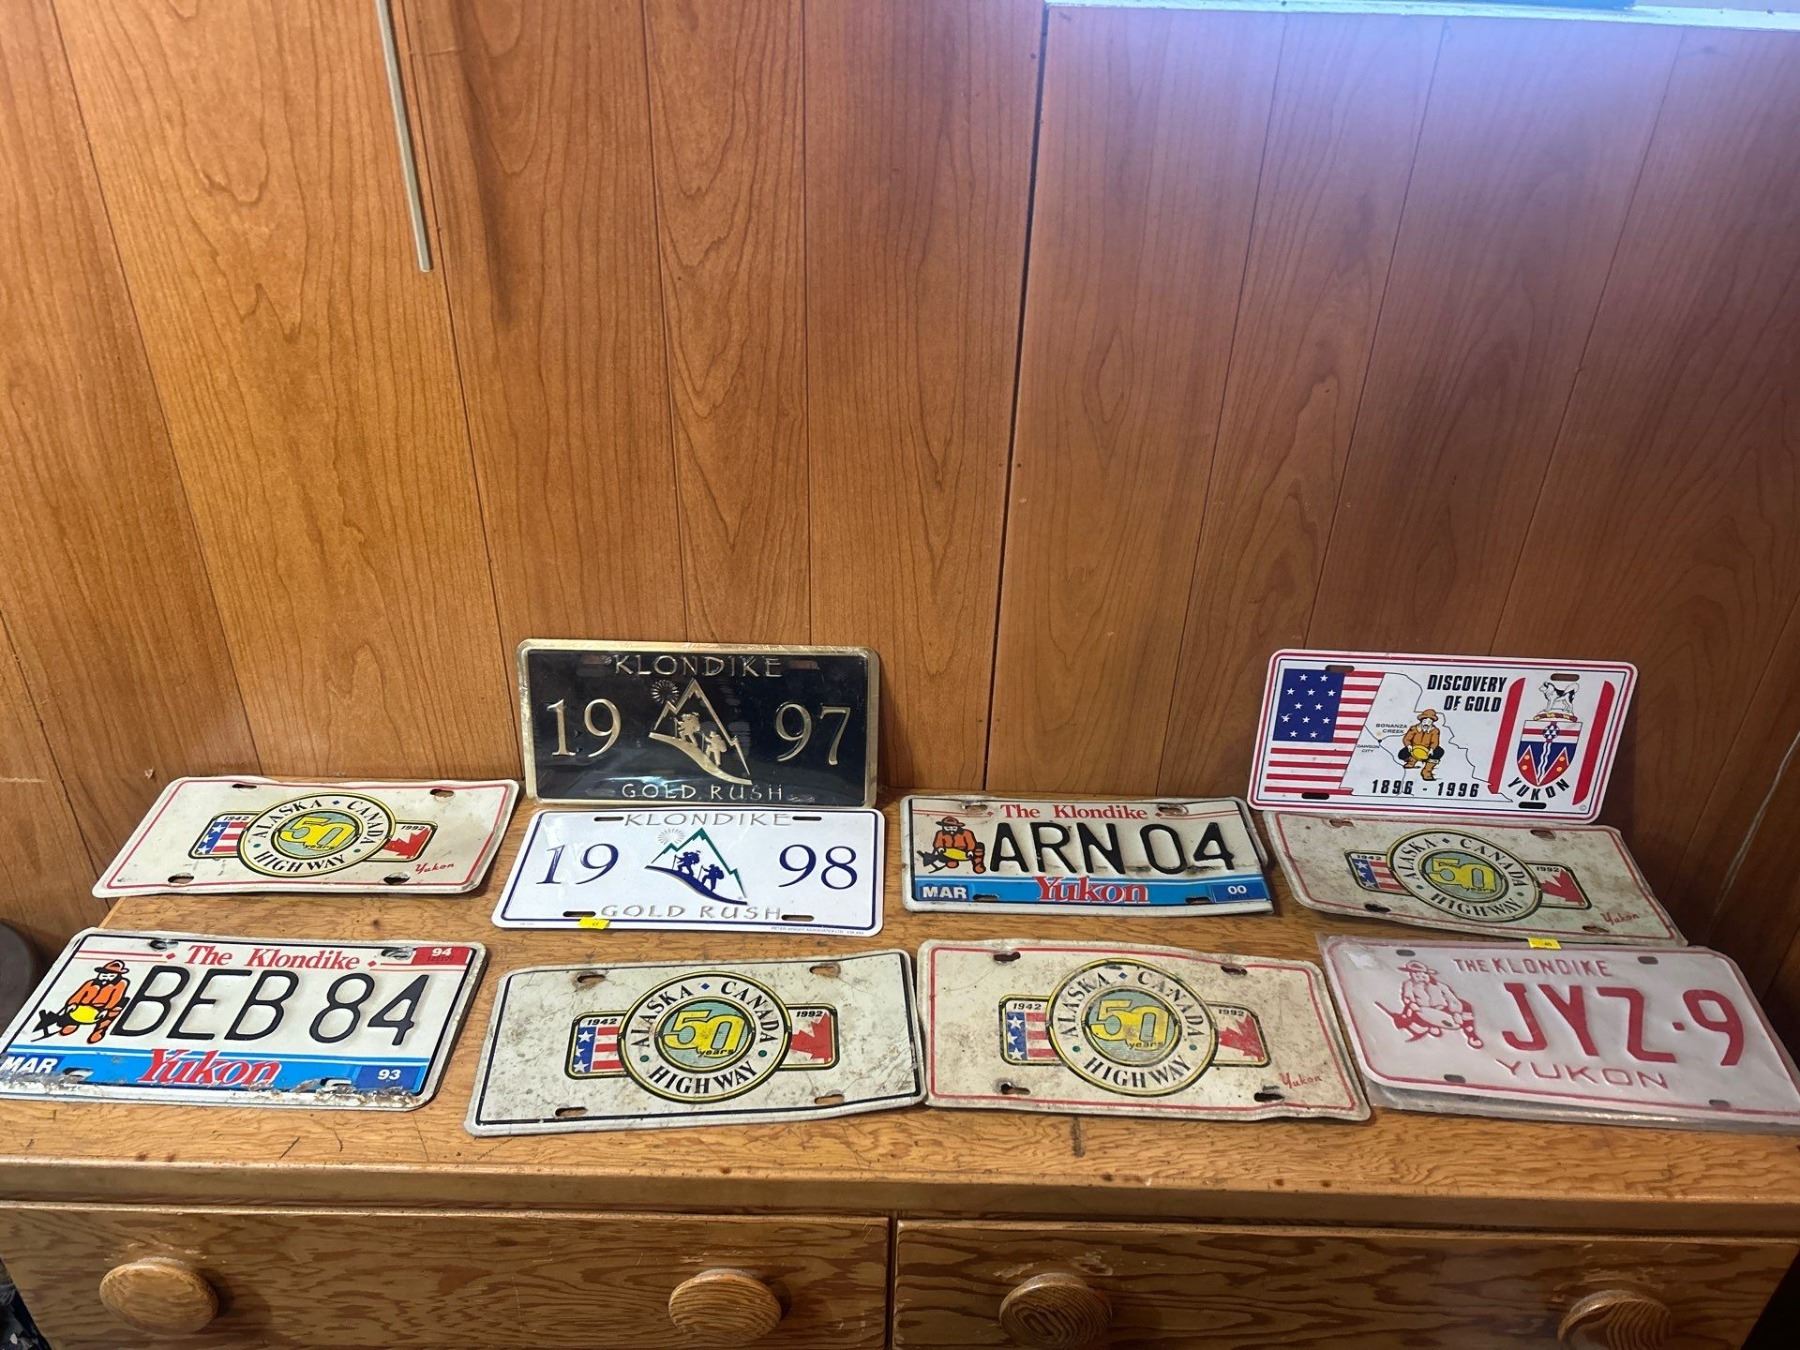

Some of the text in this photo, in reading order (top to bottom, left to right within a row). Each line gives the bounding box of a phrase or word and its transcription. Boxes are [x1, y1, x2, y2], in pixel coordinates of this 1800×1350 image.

[614, 654, 783, 678] KLONDIKE
[1426, 674, 1507, 693] DISCOVERY
[1443, 695, 1502, 713] OF GOLD
[547, 699, 851, 766] 19 97
[622, 783, 783, 801] GOLD RUSH
[1372, 779, 1413, 795] 1896
[1437, 782, 1480, 797] 1996
[1507, 777, 1570, 801] YUKON
[253, 800, 385, 845] ALASKA CANADA
[624, 813, 793, 827] KLONDIKE
[1001, 804, 1148, 820] The Klondike
[279, 816, 356, 848] 50
[990, 822, 1235, 875] ARN 04
[253, 850, 346, 873] HIGHWAY
[415, 862, 455, 875] Yukon
[536, 843, 858, 890] 19 98
[1401, 837, 1528, 888] ALASKA CANADA
[1429, 858, 1496, 891] 50
[922, 885, 967, 900] MAR
[1032, 875, 1149, 904] Yukon
[1227, 885, 1248, 895] 00
[601, 904, 781, 920] GOLD RUSH
[1430, 892, 1524, 917] HIGHWAY
[1604, 911, 1640, 926] Yukon
[185, 946, 361, 970] The Klondike
[432, 948, 452, 956] 94
[1453, 958, 1612, 977] THE KLONDIKE
[110, 965, 430, 1046] BEB 84
[631, 981, 779, 1047] ALASKA CANADA
[796, 1010, 824, 1018] 1992
[1012, 1003, 1042, 1011] 1942
[1059, 971, 1206, 1038] ALASKA CANADA
[586, 1018, 618, 1027] 1942
[662, 1009, 744, 1057] 50
[1089, 999, 1168, 1051] 50
[698, 1047, 736, 1057] years
[1128, 1040, 1164, 1051] years
[0, 1056, 58, 1074] MAR
[137, 1050, 284, 1088] Yukon
[377, 1069, 401, 1081] 93
[1084, 1055, 1192, 1088] HIGHWAY
[1495, 1058, 1670, 1090] YUKON
[648, 1062, 758, 1094] HIGHWAY
[1279, 1072, 1322, 1088] Yukon
